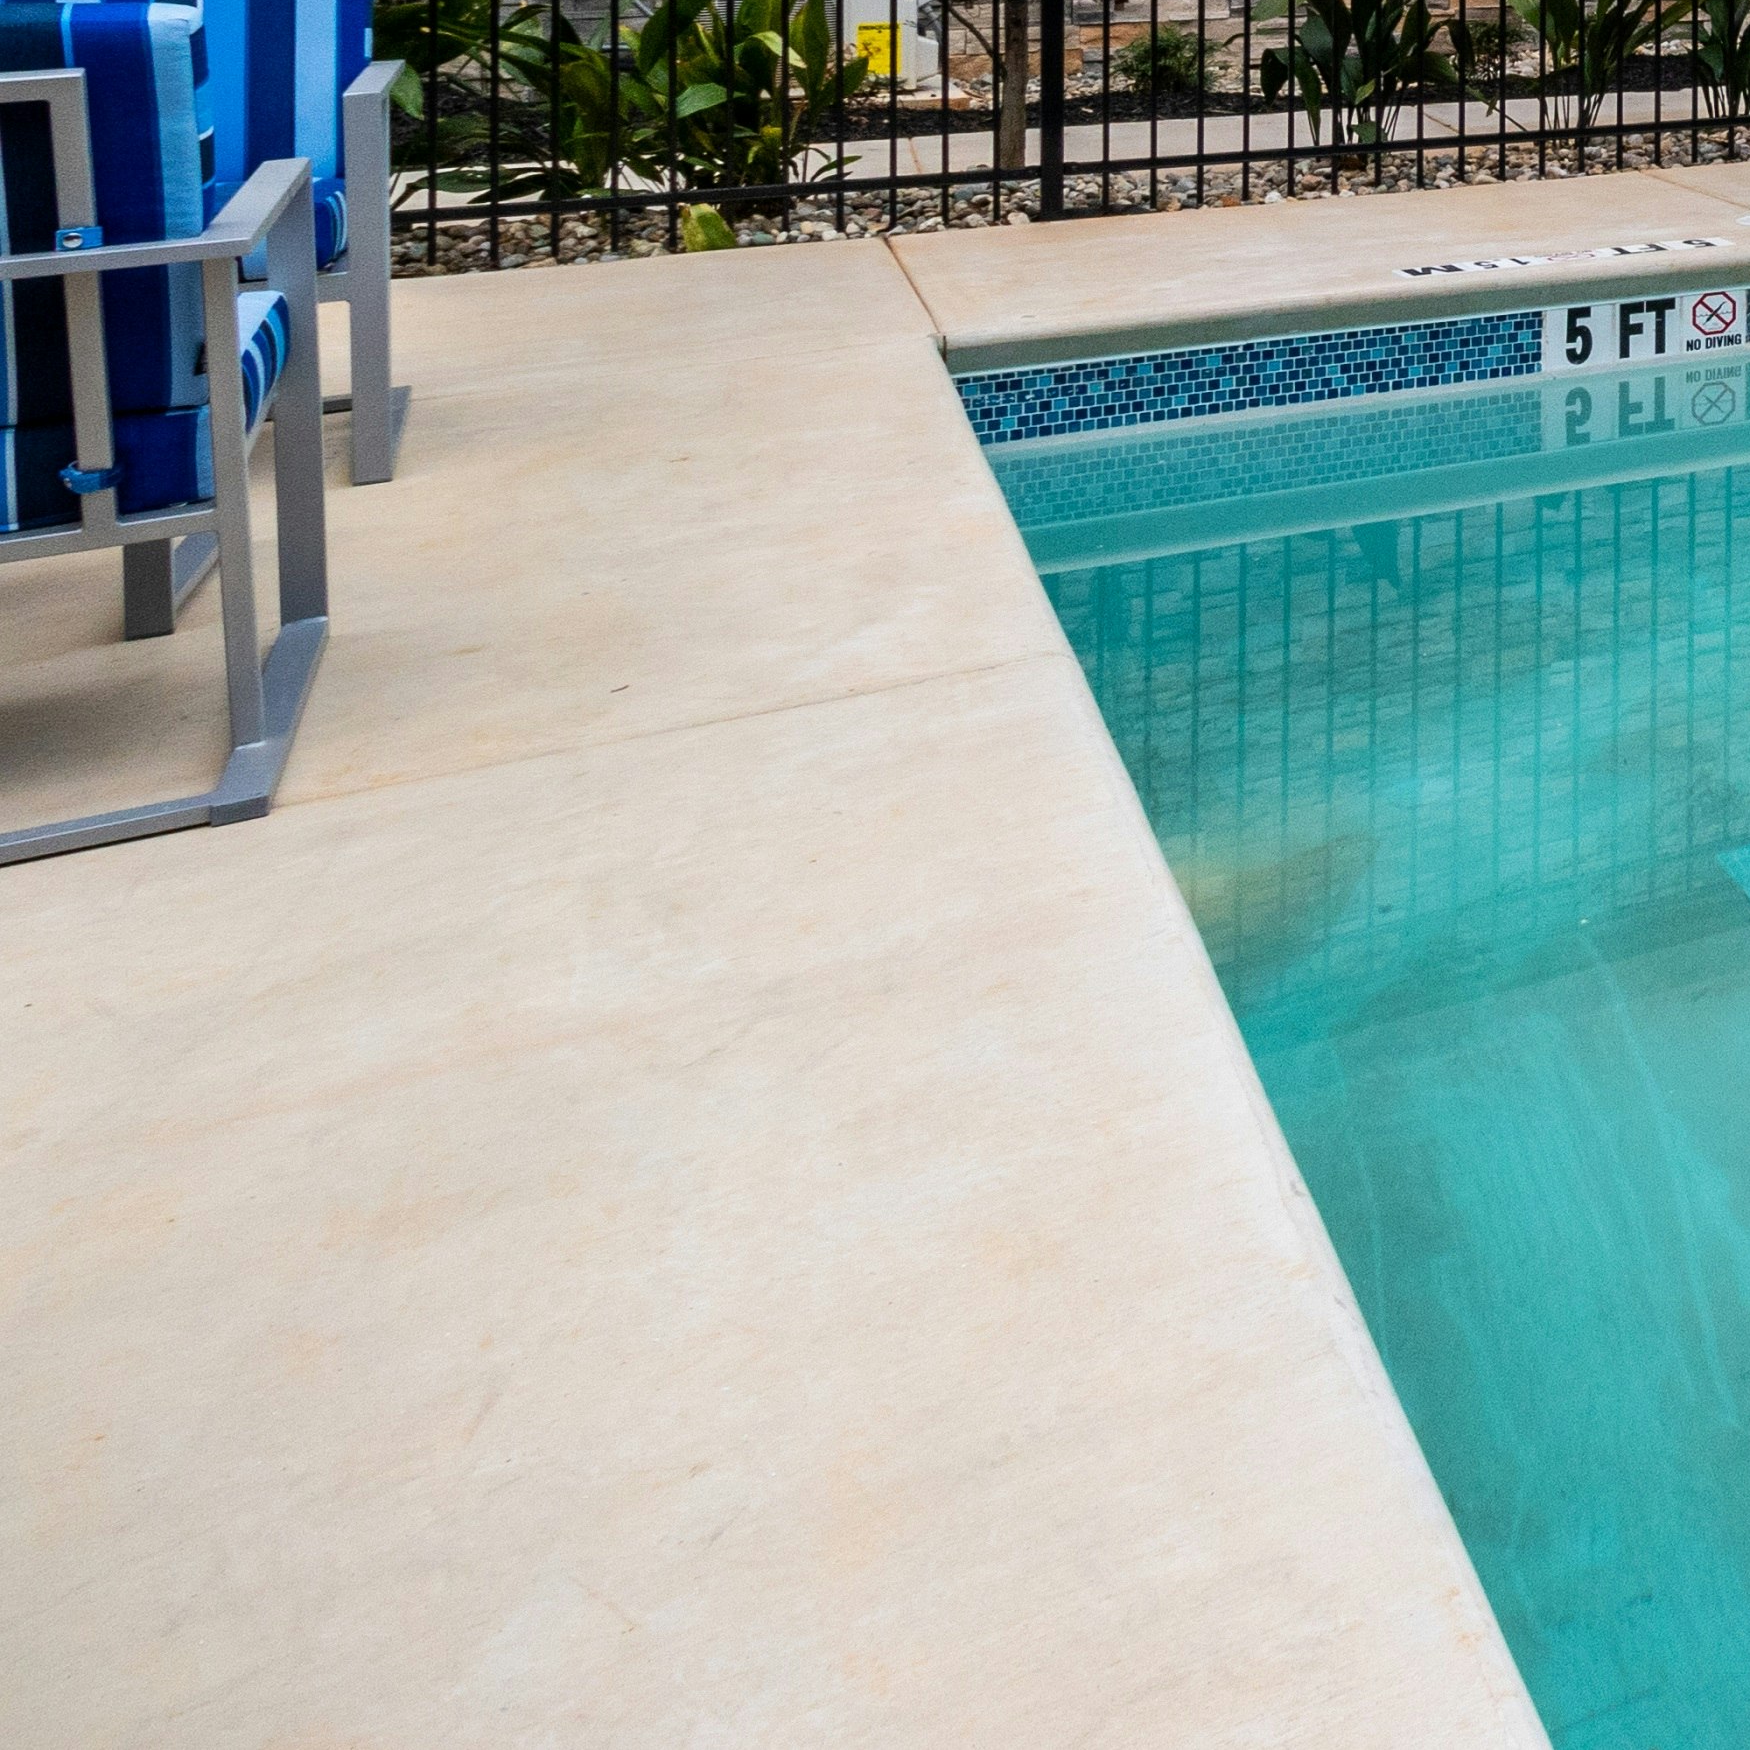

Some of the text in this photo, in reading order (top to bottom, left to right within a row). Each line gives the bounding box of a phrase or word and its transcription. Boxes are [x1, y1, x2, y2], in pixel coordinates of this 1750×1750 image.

[1565, 297, 1676, 365] 5 FT
[1686, 334, 1742, 352] NO DIVING
